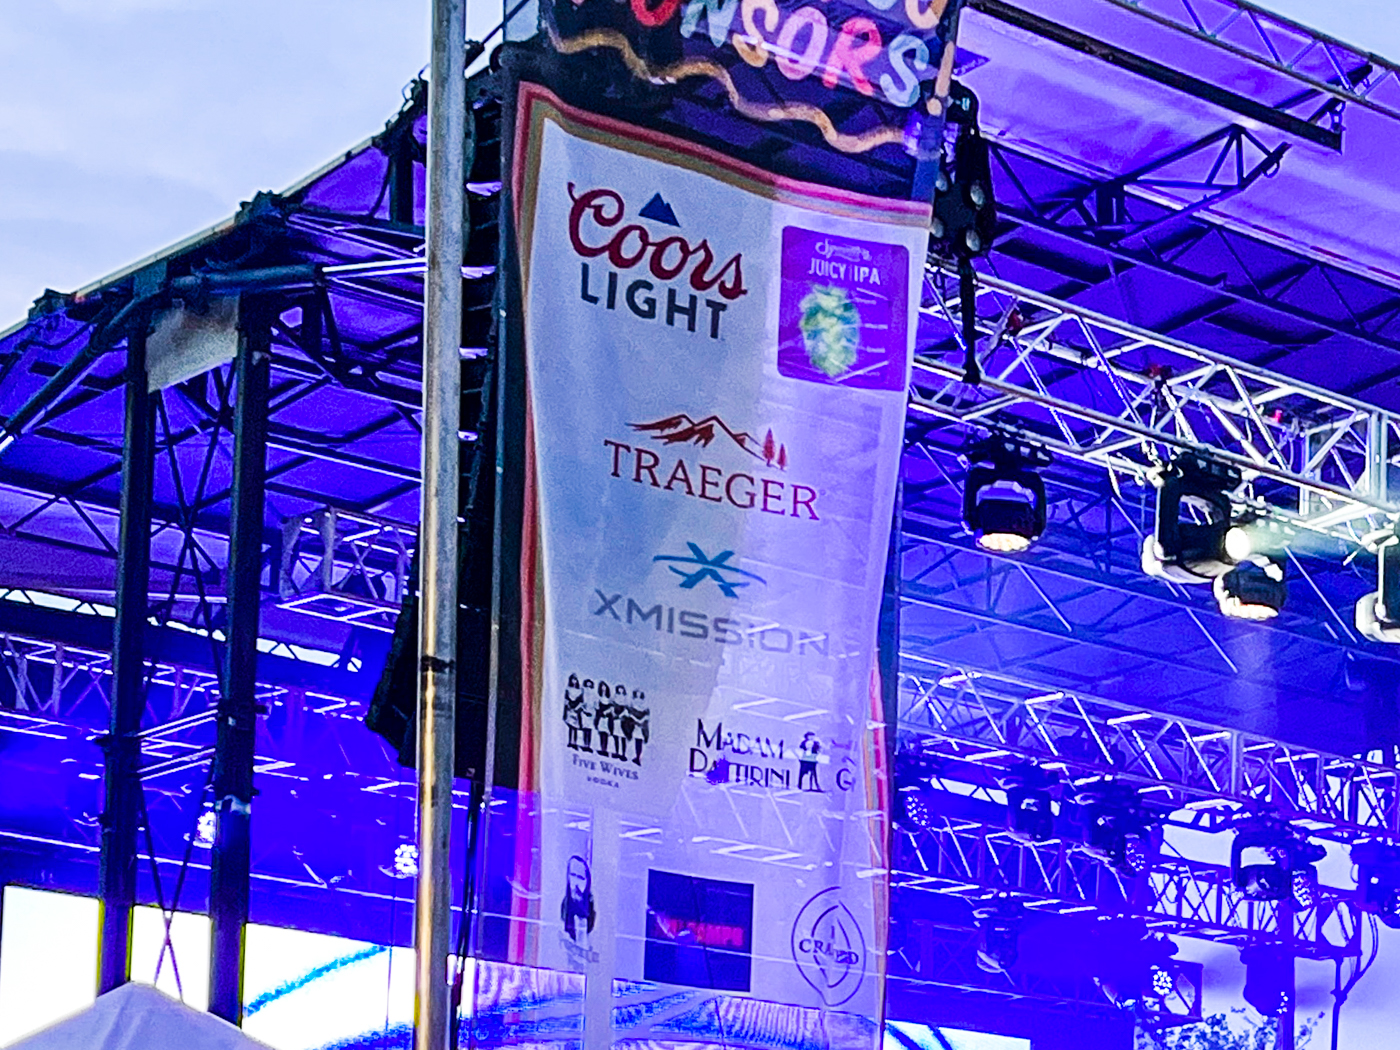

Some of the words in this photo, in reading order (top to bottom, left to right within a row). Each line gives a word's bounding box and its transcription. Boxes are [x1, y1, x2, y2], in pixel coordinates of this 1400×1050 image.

[567, 182, 748, 301] Coors
[808, 257, 847, 281] JUICY
[853, 264, 881, 286] IPA
[580, 263, 728, 339] LIGHT
[603, 440, 820, 521] TRAEGER
[594, 588, 830, 656] XMISSION
